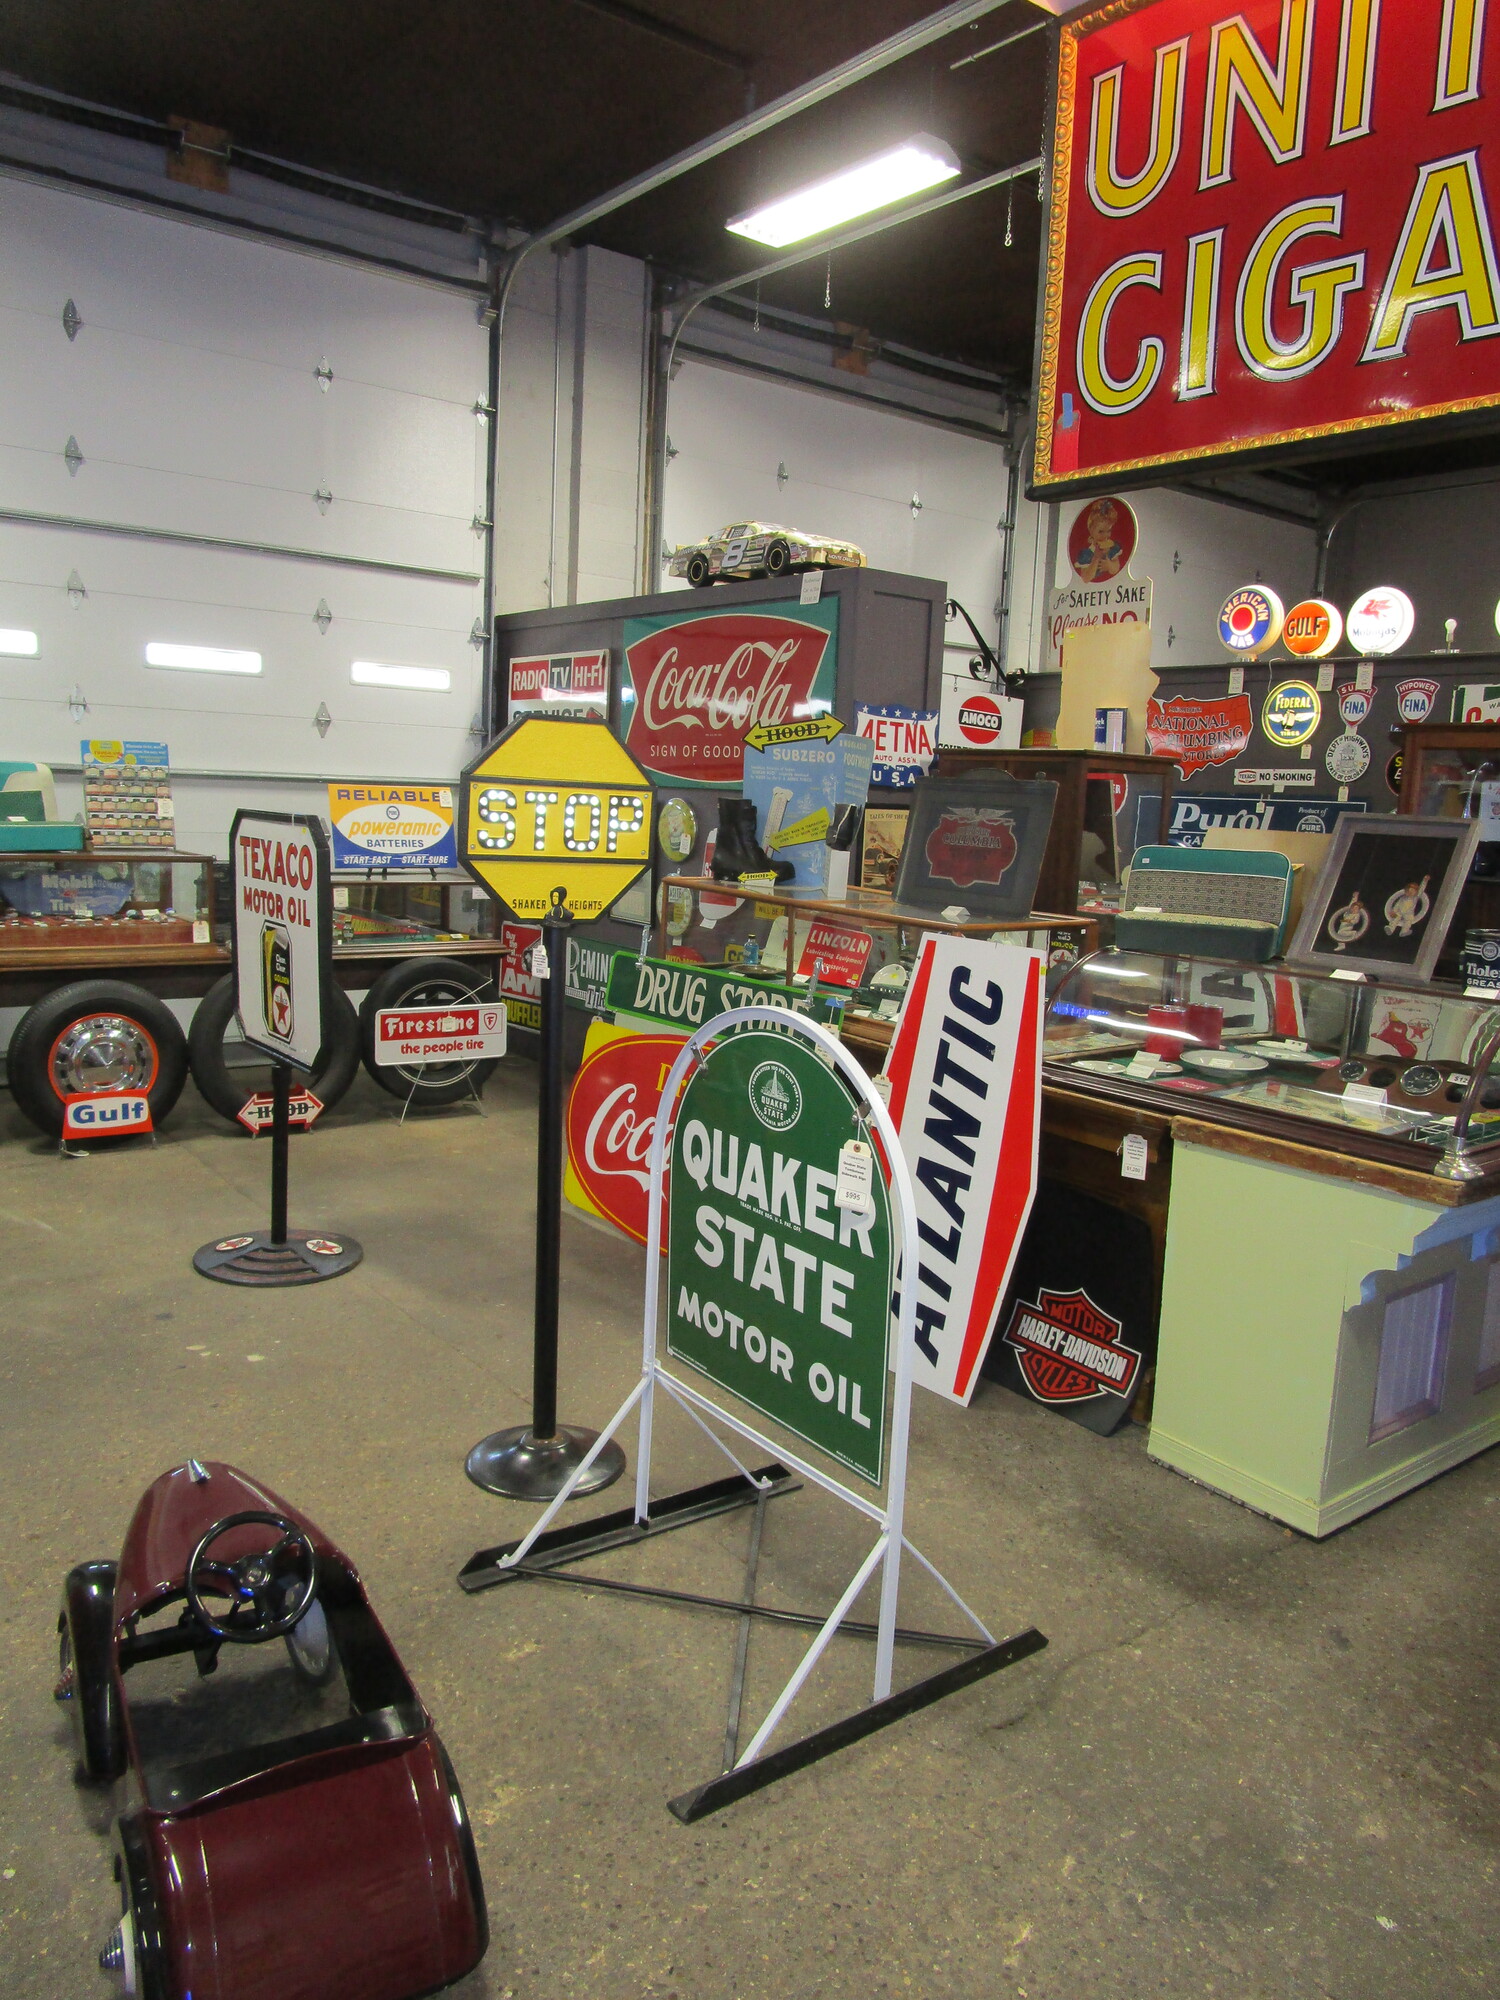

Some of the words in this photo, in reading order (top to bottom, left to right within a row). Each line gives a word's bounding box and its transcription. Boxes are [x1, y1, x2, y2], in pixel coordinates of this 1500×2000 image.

[722, 539, 749, 568] 8
[1054, 593, 1069, 609] for
[1069, 590, 1111, 608] SAFETY
[1116, 585, 1146, 603] SAKE
[1222, 592, 1269, 623] AMERICAN
[1287, 616, 1327, 638] GULF
[1230, 635, 1255, 647] GAS
[513, 669, 547, 691] RADIO
[551, 666, 570, 688] TV
[574, 661, 602, 687] HI-FI
[644, 639, 801, 731] Coca-Cola
[1400, 681, 1435, 692] HYPOWER
[1275, 694, 1312, 711] FEDERAL
[1344, 702, 1365, 714] FINA
[1404, 699, 1426, 713] FINA
[961, 711, 998, 729] AMOCO
[1152, 713, 1229, 731] NATIONAL
[767, 723, 820, 742] HOOD
[862, 719, 932, 755] AETNA
[1166, 725, 1243, 748] PLUMBING
[650, 745, 676, 757] SIGN
[682, 746, 698, 757] OF
[703, 745, 741, 757] GOOD
[773, 748, 836, 763] SUBZERO
[1183, 747, 1226, 762] STORES
[1343, 735, 1369, 759] HIGHWAYS
[874, 754, 893, 762] AUTO
[1259, 773, 1271, 781] NO
[1273, 773, 1312, 782] SMOKING
[1326, 761, 1338, 776] STATE
[1343, 762, 1368, 781] COLORADO
[337, 789, 441, 802] RELIABLE
[1171, 802, 1275, 830] Purol
[1299, 806, 1321, 814] Product
[1321, 808, 1329, 817] of
[348, 821, 442, 838] poweramic
[477, 789, 644, 853] STOP
[367, 839, 424, 848] BATTERIES
[240, 836, 313, 891] TEXACO
[344, 856, 369, 864] START
[372, 856, 392, 864] FAST
[402, 856, 425, 864] START
[428, 856, 449, 864] SURE
[42, 874, 94, 888] Mobil
[745, 872, 769, 880] HOOD
[243, 886, 285, 920] MOTOR
[287, 896, 311, 928] OIL
[512, 899, 547, 909] SHAKER
[569, 900, 602, 910] HEIGHTS
[810, 930, 869, 954] LINCOLN
[565, 937, 613, 989] REMIN
[1467, 962, 1500, 980] Tiole
[634, 965, 707, 1024] DRUG
[385, 1017, 475, 1038] Firestne
[401, 1043, 420, 1054] the
[423, 1040, 463, 1055] people
[466, 1039, 484, 1050] tire
[257, 1102, 309, 1119] HOD
[761, 1095, 788, 1111] QUAKER
[72, 1101, 144, 1124] Gulf
[763, 1107, 784, 1121] STATE
[890, 964, 1003, 1369] ATLANTIC
[682, 1118, 877, 1259] QUAKER
[845, 1191, 861, 1200] $995
[752, 1207, 764, 1216] MARK
[694, 1205, 855, 1339] STATE
[1050, 1303, 1107, 1340] MOTOR
[1017, 1314, 1128, 1382] HARLEY-DAVIDSON
[677, 1285, 794, 1384] MOTOR
[808, 1362, 871, 1430] OIL
[1031, 1354, 1089, 1392] CYCLES
